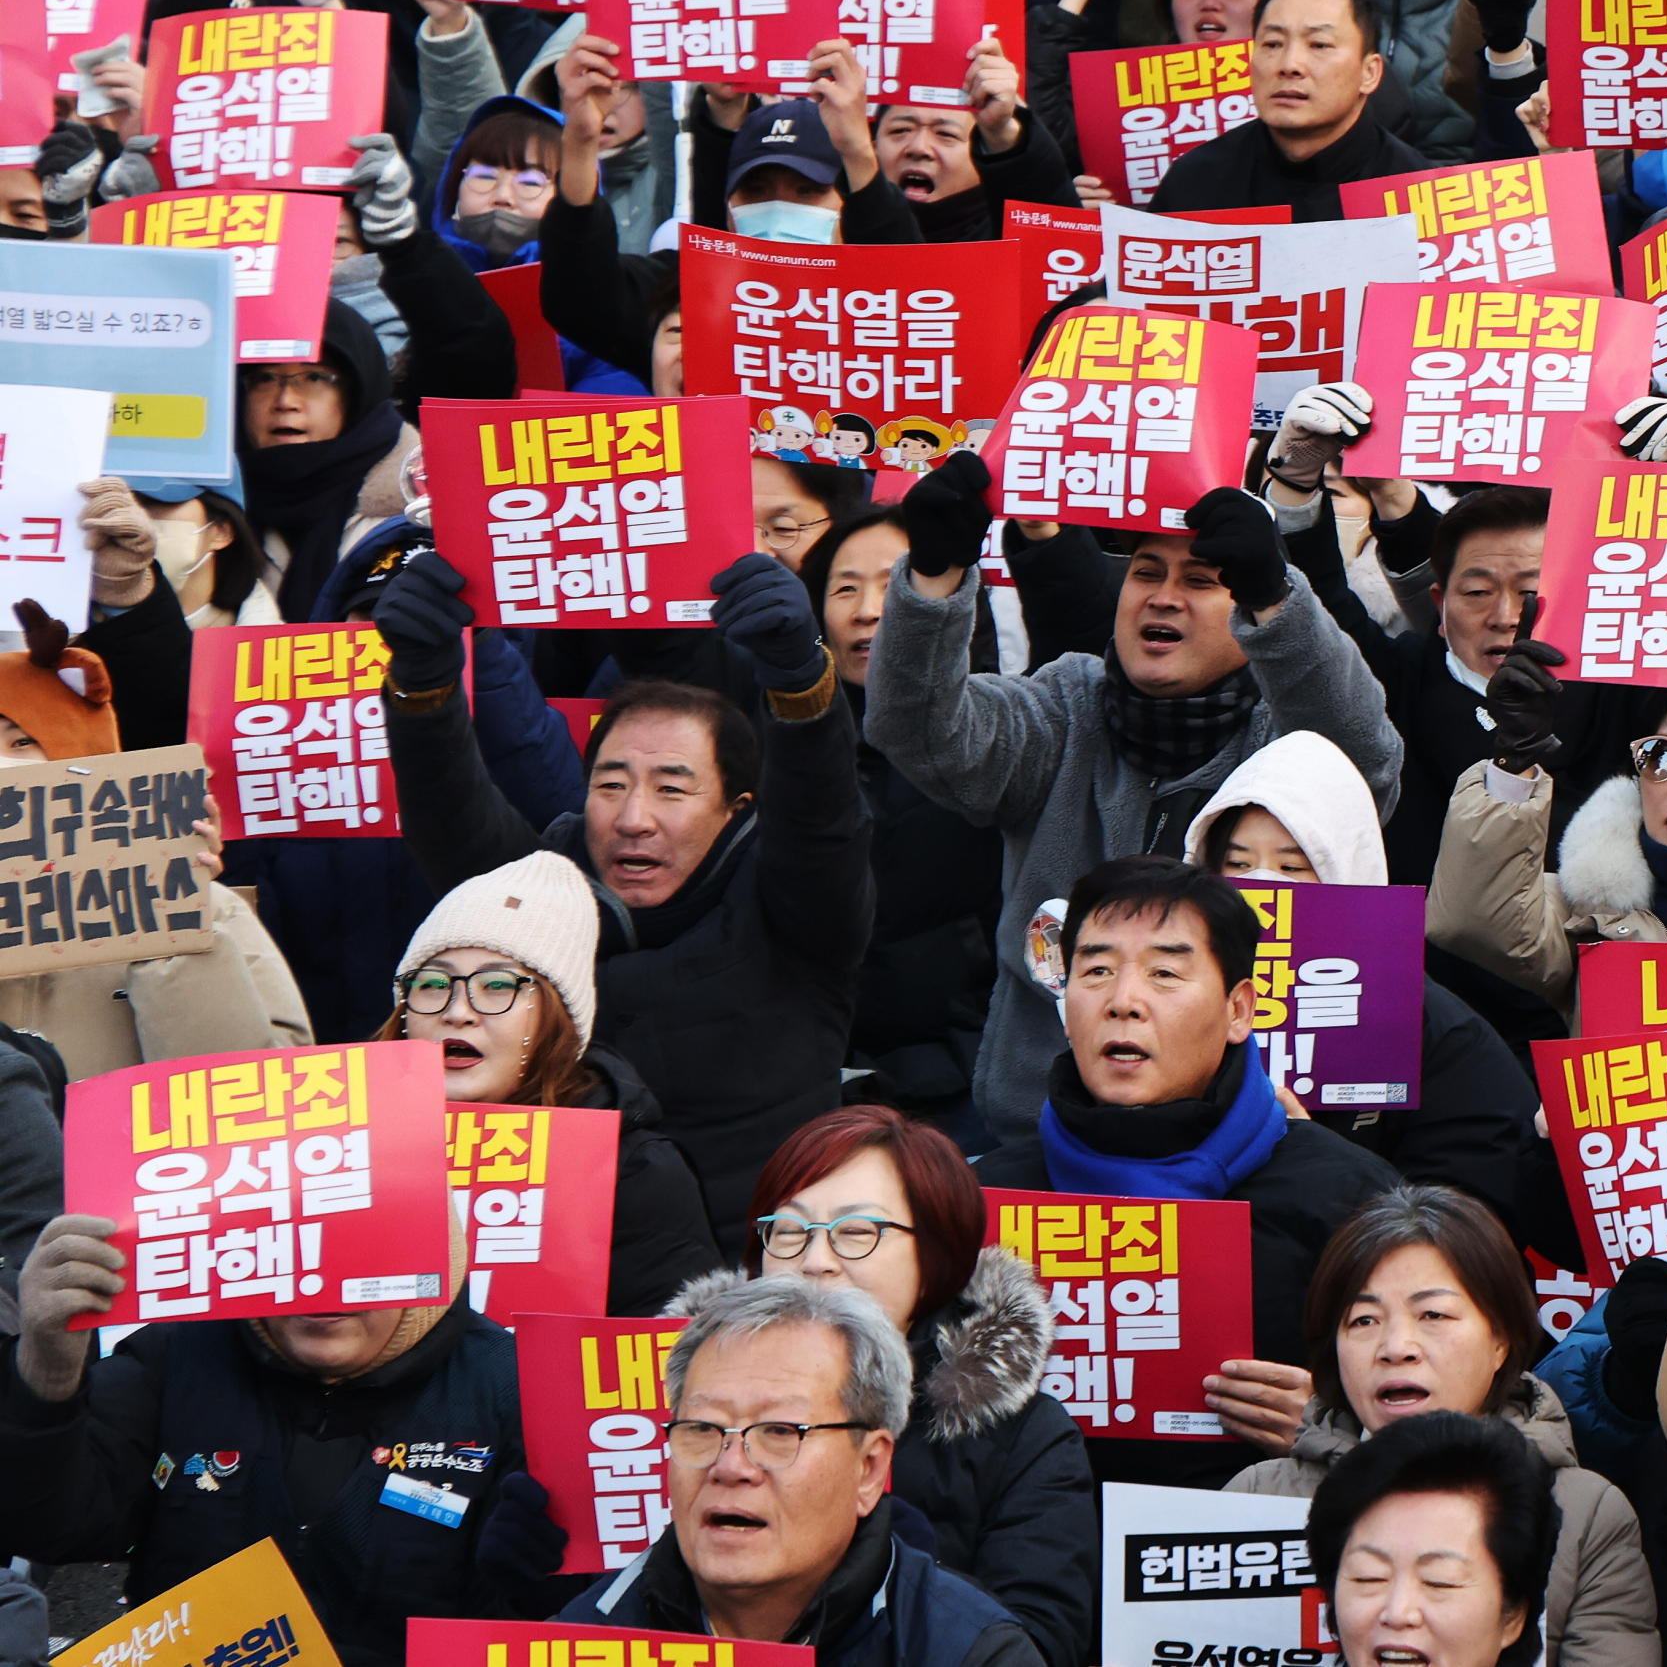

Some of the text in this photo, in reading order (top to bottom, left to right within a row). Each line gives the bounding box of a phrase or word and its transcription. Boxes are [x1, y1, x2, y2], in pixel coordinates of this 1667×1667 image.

[179, 12, 332, 74] 내란죄
[173, 67, 328, 131] 윤석열
[170, 126, 291, 187] 탄핵!
[741, 249, 836, 269] www.nanum.com
[1123, 241, 1253, 291] 윤석열
[731, 280, 961, 349] 윤석열을
[733, 342, 961, 413] 탄핵하라
[1029, 315, 1203, 385] 내란죄
[478, 406, 681, 487] 내란죄
[1010, 380, 1197, 452] 윤석열
[487, 478, 686, 557] 윤석열
[1003, 448, 1148, 519] 탄핵!
[490, 556, 647, 625] 탄핵!
[131, 1048, 368, 1155] 내란죄
[134, 1135, 371, 1232] 윤석열
[137, 1223, 323, 1320] 탄핵!
